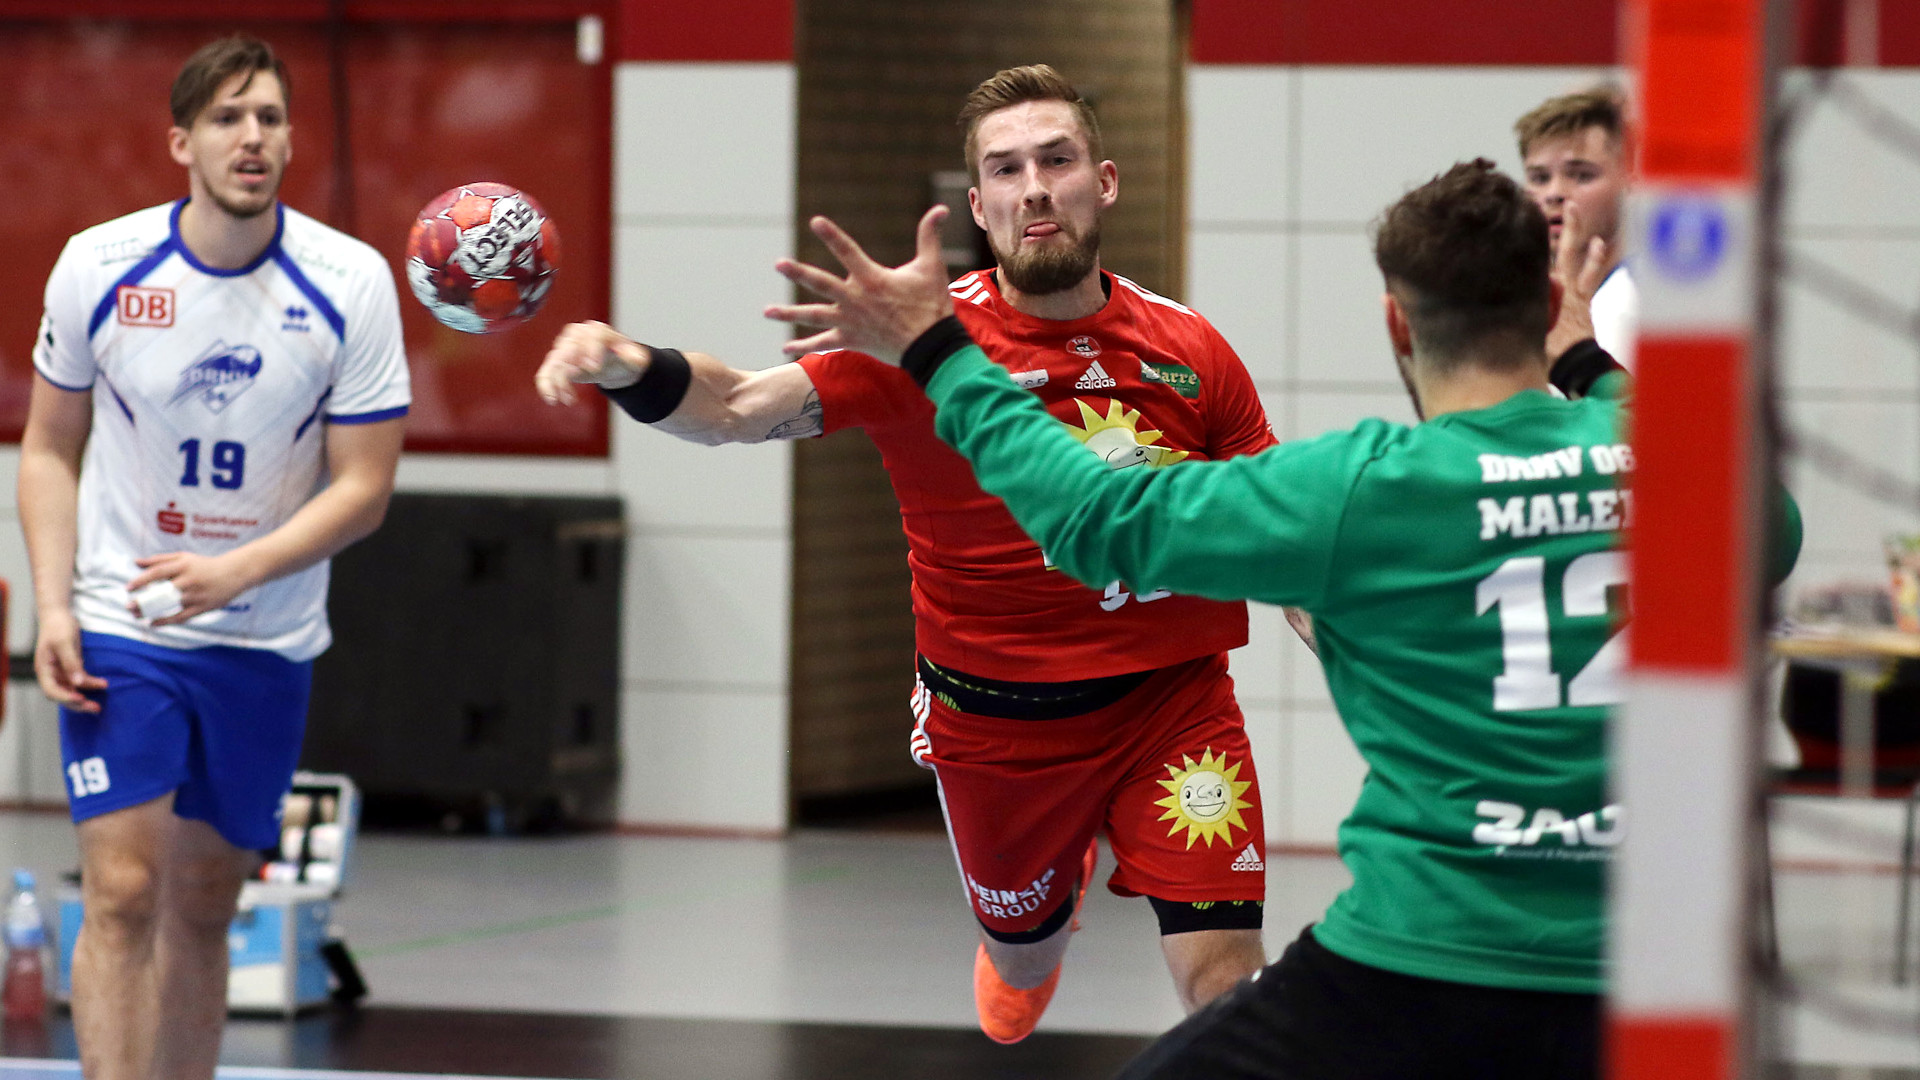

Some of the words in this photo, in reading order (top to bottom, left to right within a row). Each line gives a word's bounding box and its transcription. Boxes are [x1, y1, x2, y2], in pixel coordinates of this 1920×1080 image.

[466, 201, 535, 273] SELECT
[125, 294, 166, 320] DB
[1075, 378, 1117, 390] adidas
[178, 437, 246, 491] 19
[1475, 551, 1634, 712] 12
[67, 756, 111, 798] 19
[1230, 862, 1265, 872] adidas
[977, 884, 1051, 919] GROUP
